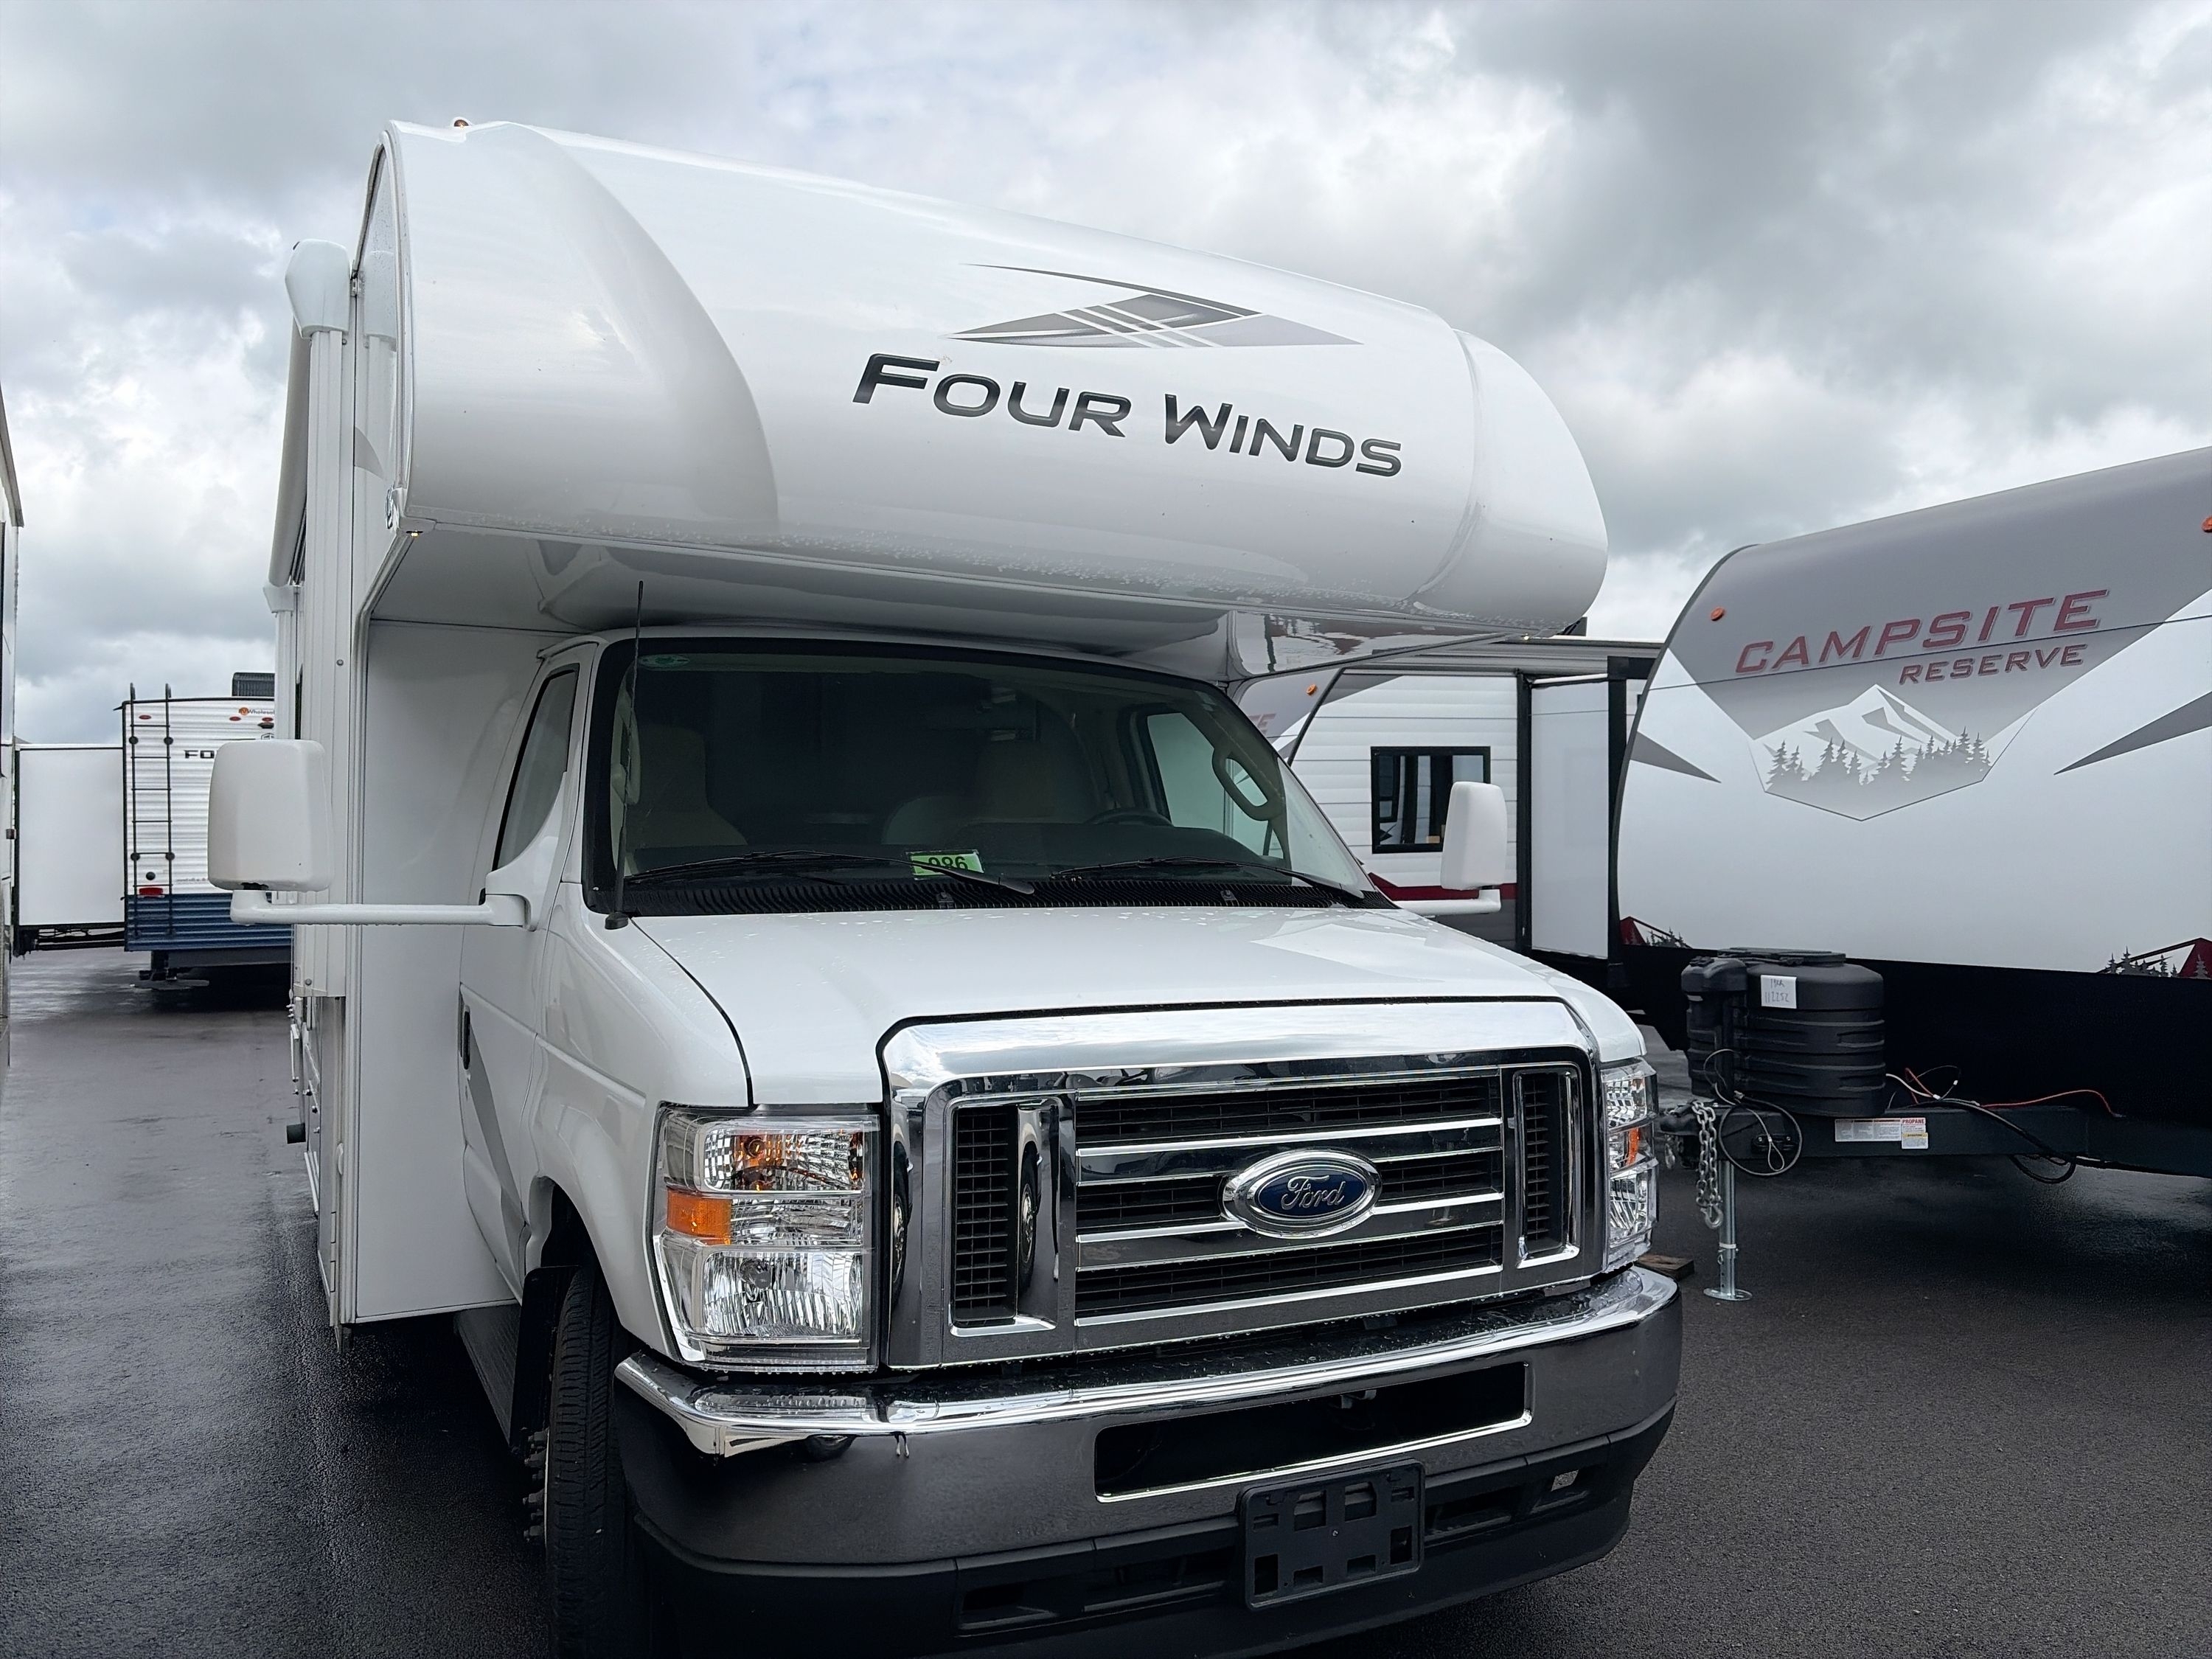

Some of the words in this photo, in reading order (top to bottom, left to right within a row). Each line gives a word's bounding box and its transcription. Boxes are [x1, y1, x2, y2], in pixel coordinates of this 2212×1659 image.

[1735, 588, 2110, 675] CAMPSITE
[1899, 643, 2088, 686] RESERVE
[184, 749, 215, 759] FO
[1281, 1175, 1346, 1211] Ford
